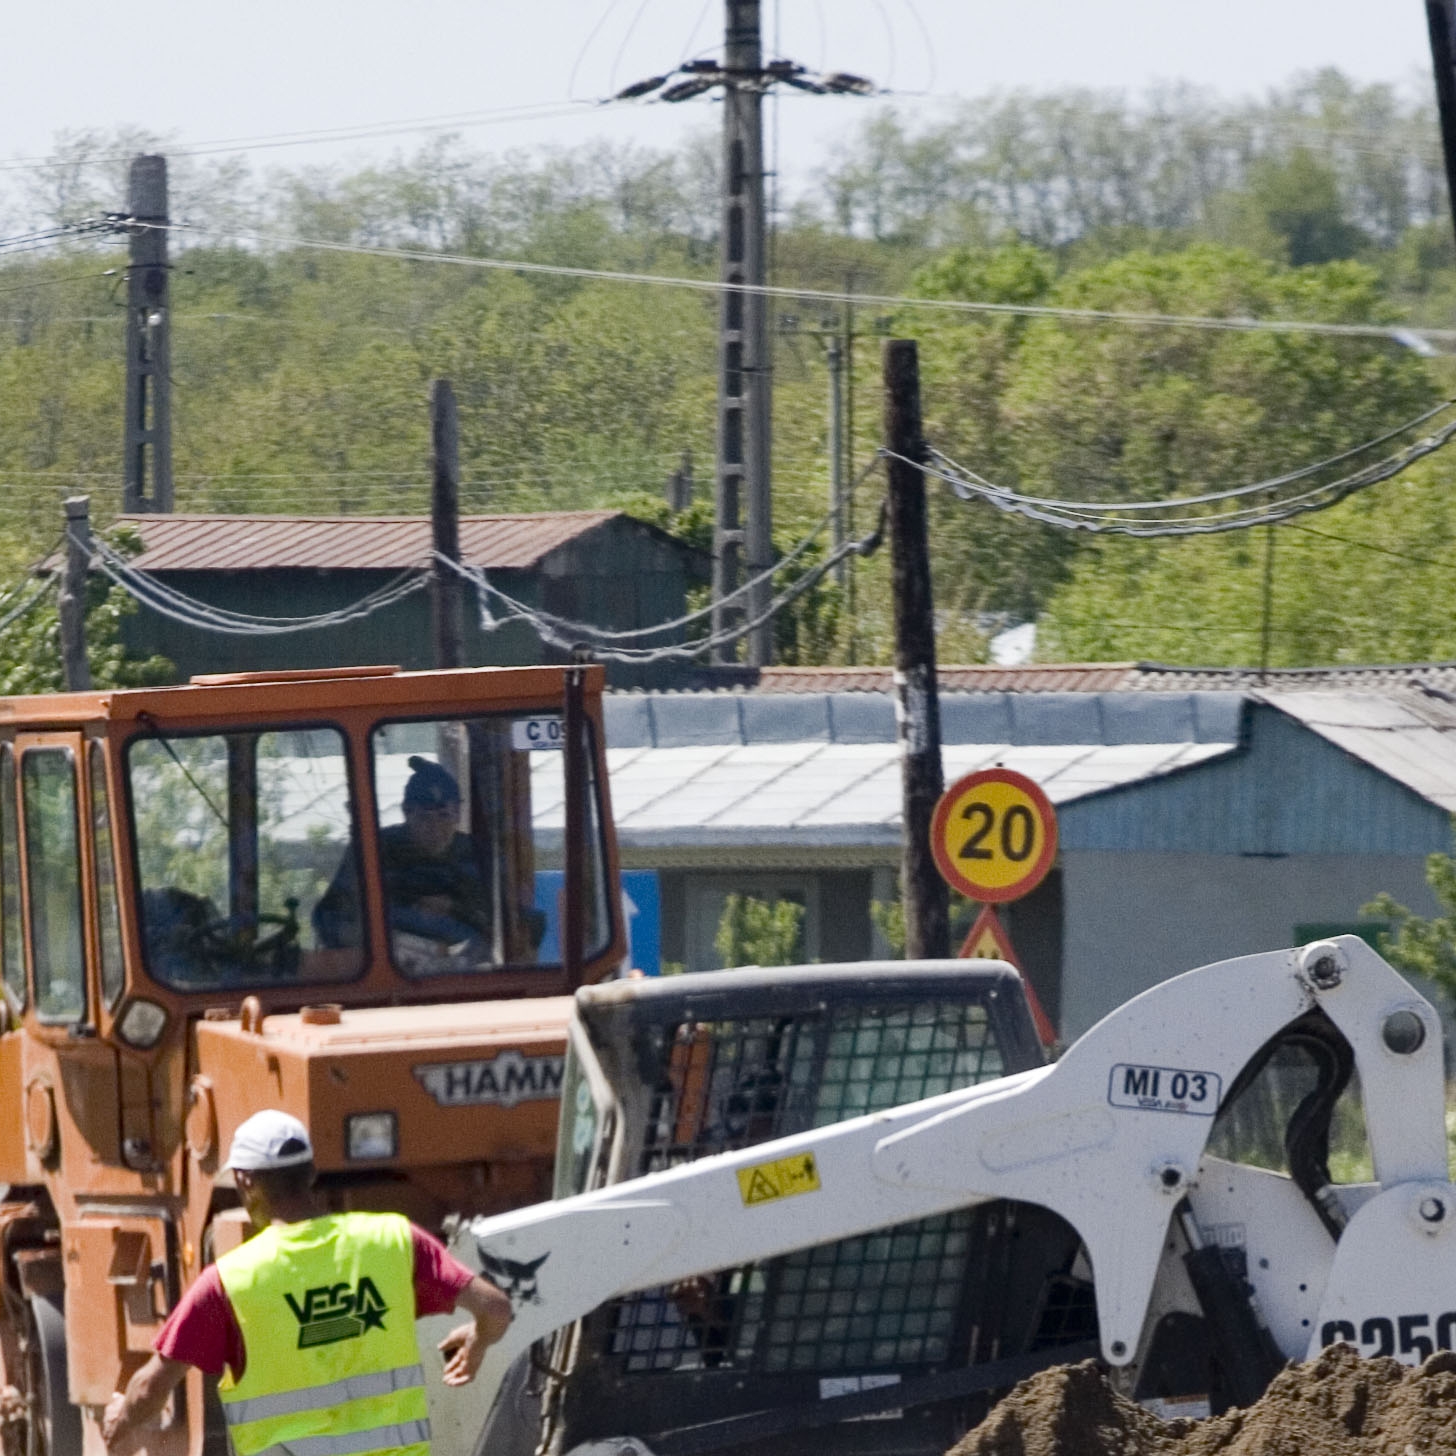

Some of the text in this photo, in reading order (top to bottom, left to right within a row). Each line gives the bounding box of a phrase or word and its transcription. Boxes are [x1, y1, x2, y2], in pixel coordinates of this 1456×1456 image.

[527, 721, 540, 741] C
[958, 802, 1035, 862] 20
[1124, 1067, 1207, 1102] MI 03
[284, 1276, 387, 1325] VEGA
